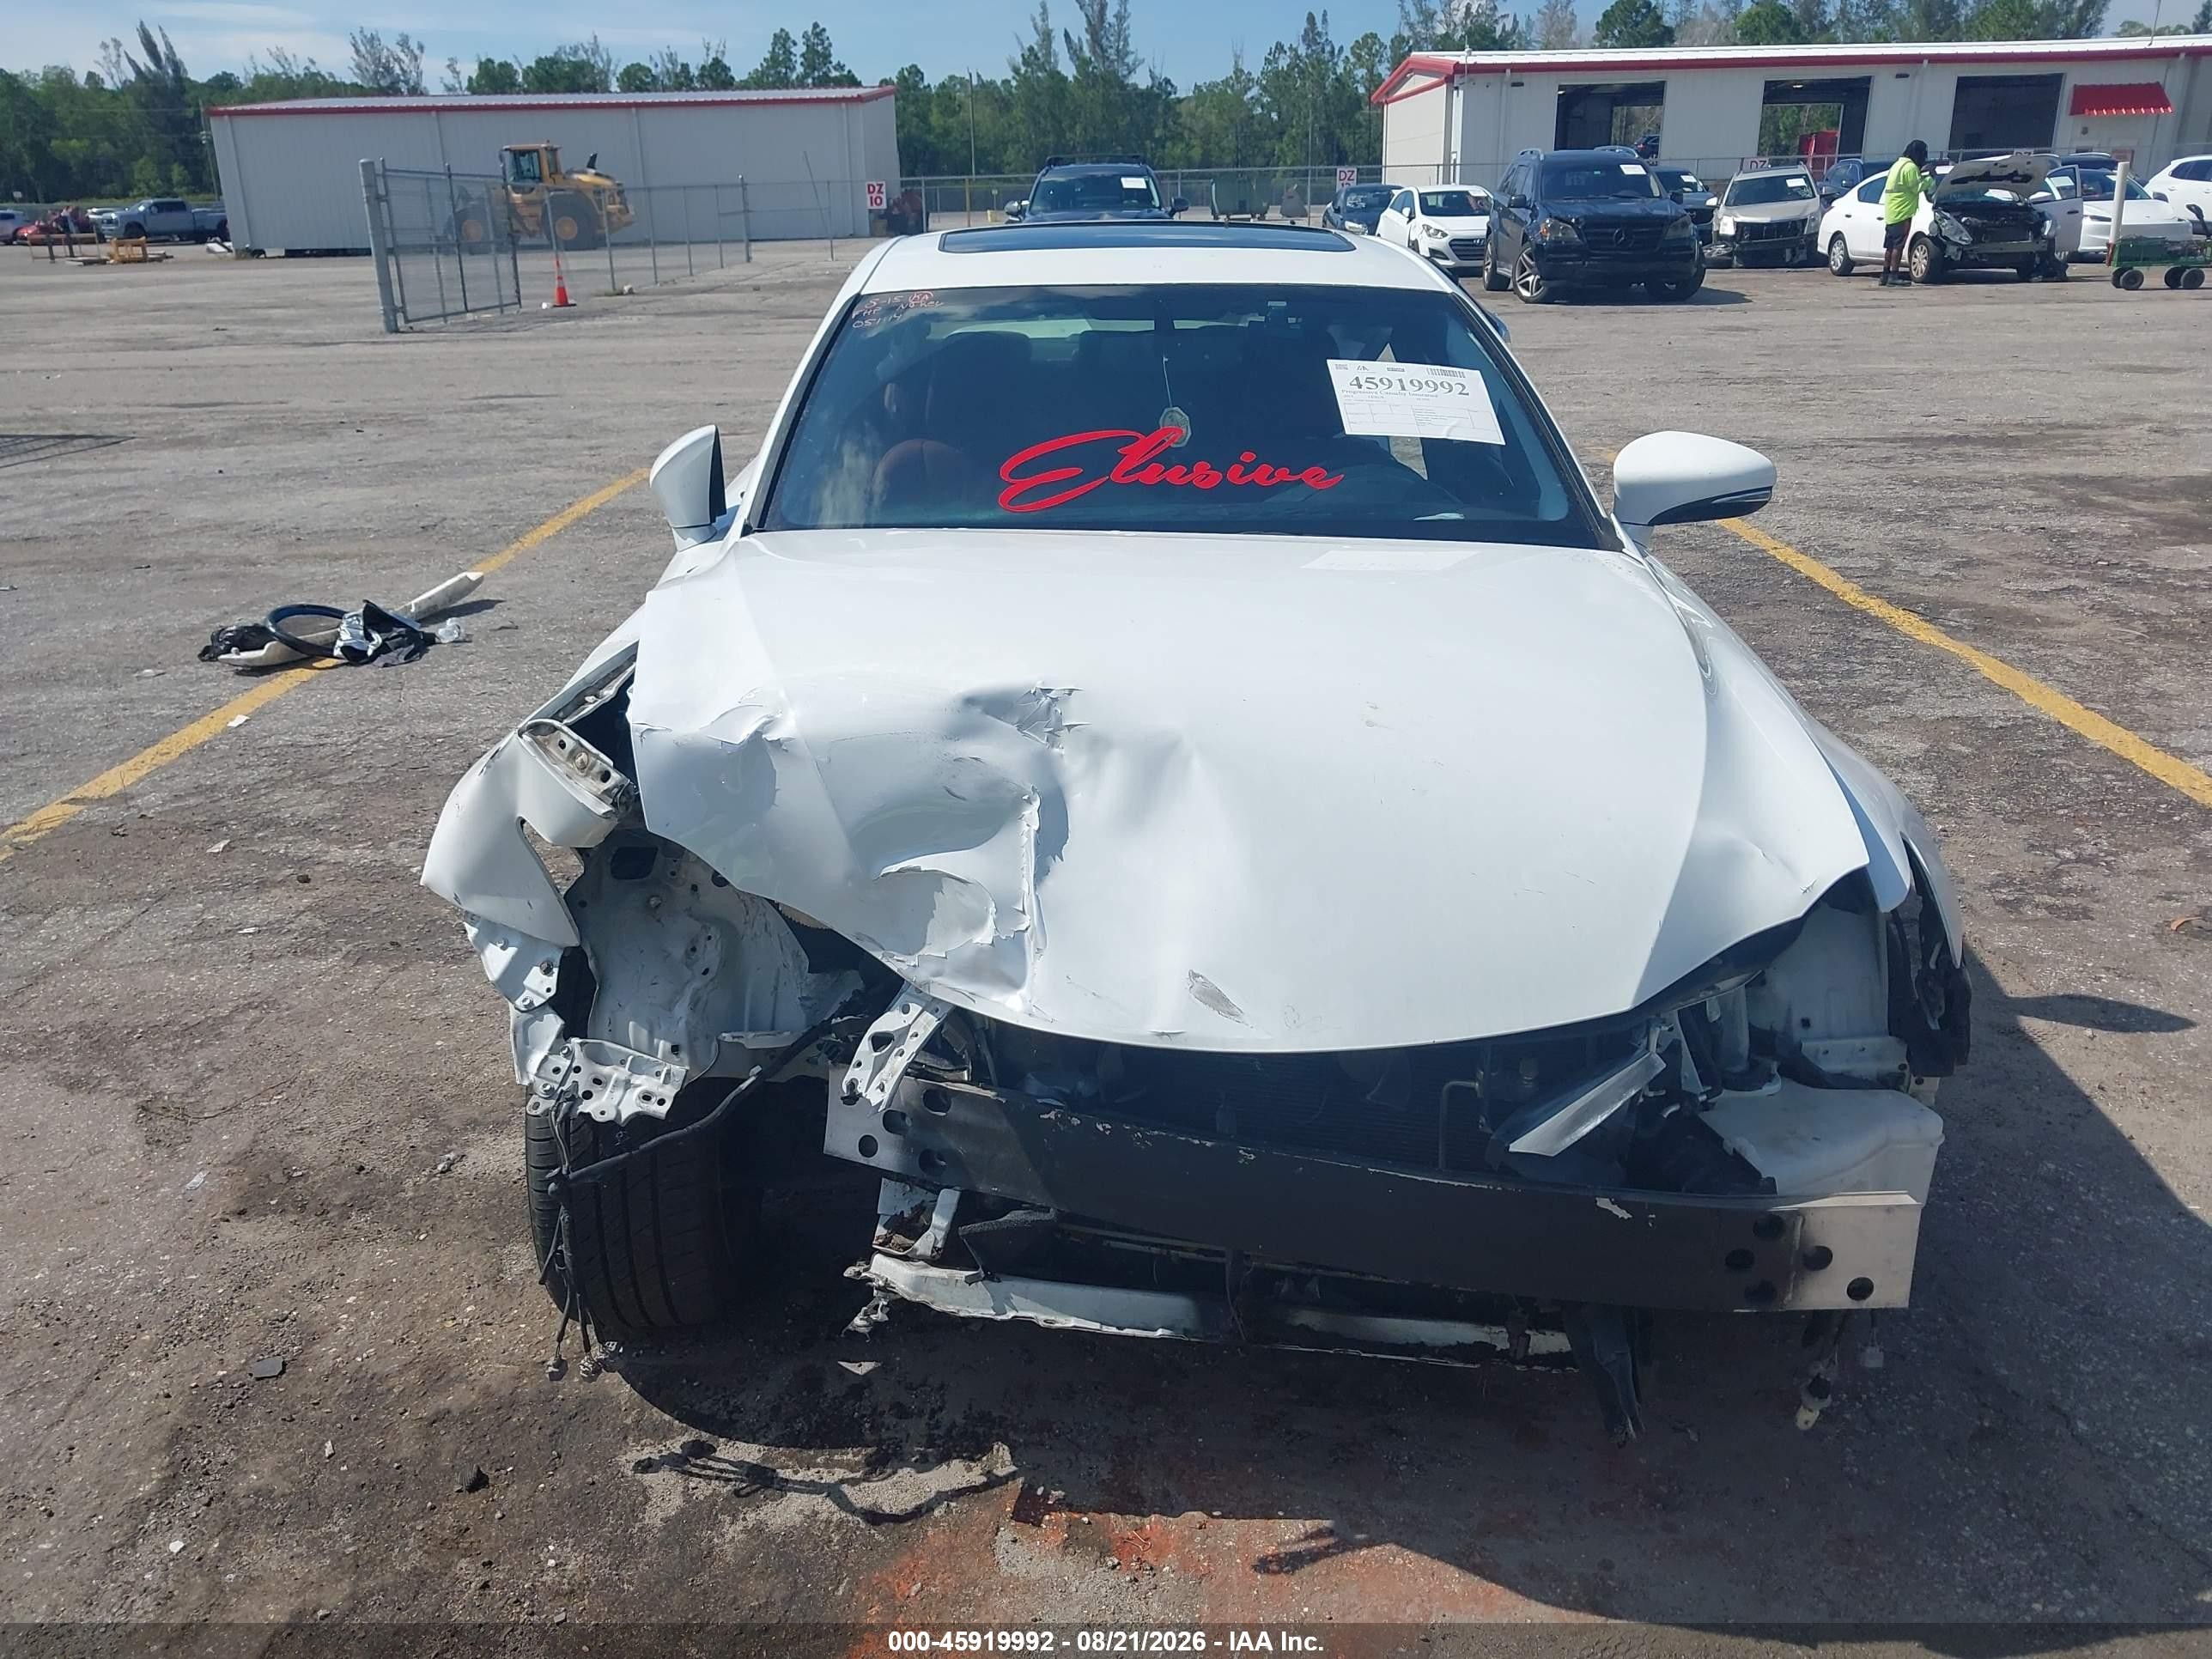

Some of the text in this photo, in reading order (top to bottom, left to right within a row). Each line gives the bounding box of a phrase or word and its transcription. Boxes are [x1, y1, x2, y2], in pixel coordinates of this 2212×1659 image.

[1339, 170, 1355, 181] DZ
[867, 183, 884, 194] DZ
[1349, 376, 1470, 396] 45919992
[999, 426, 1345, 513] Elusive
